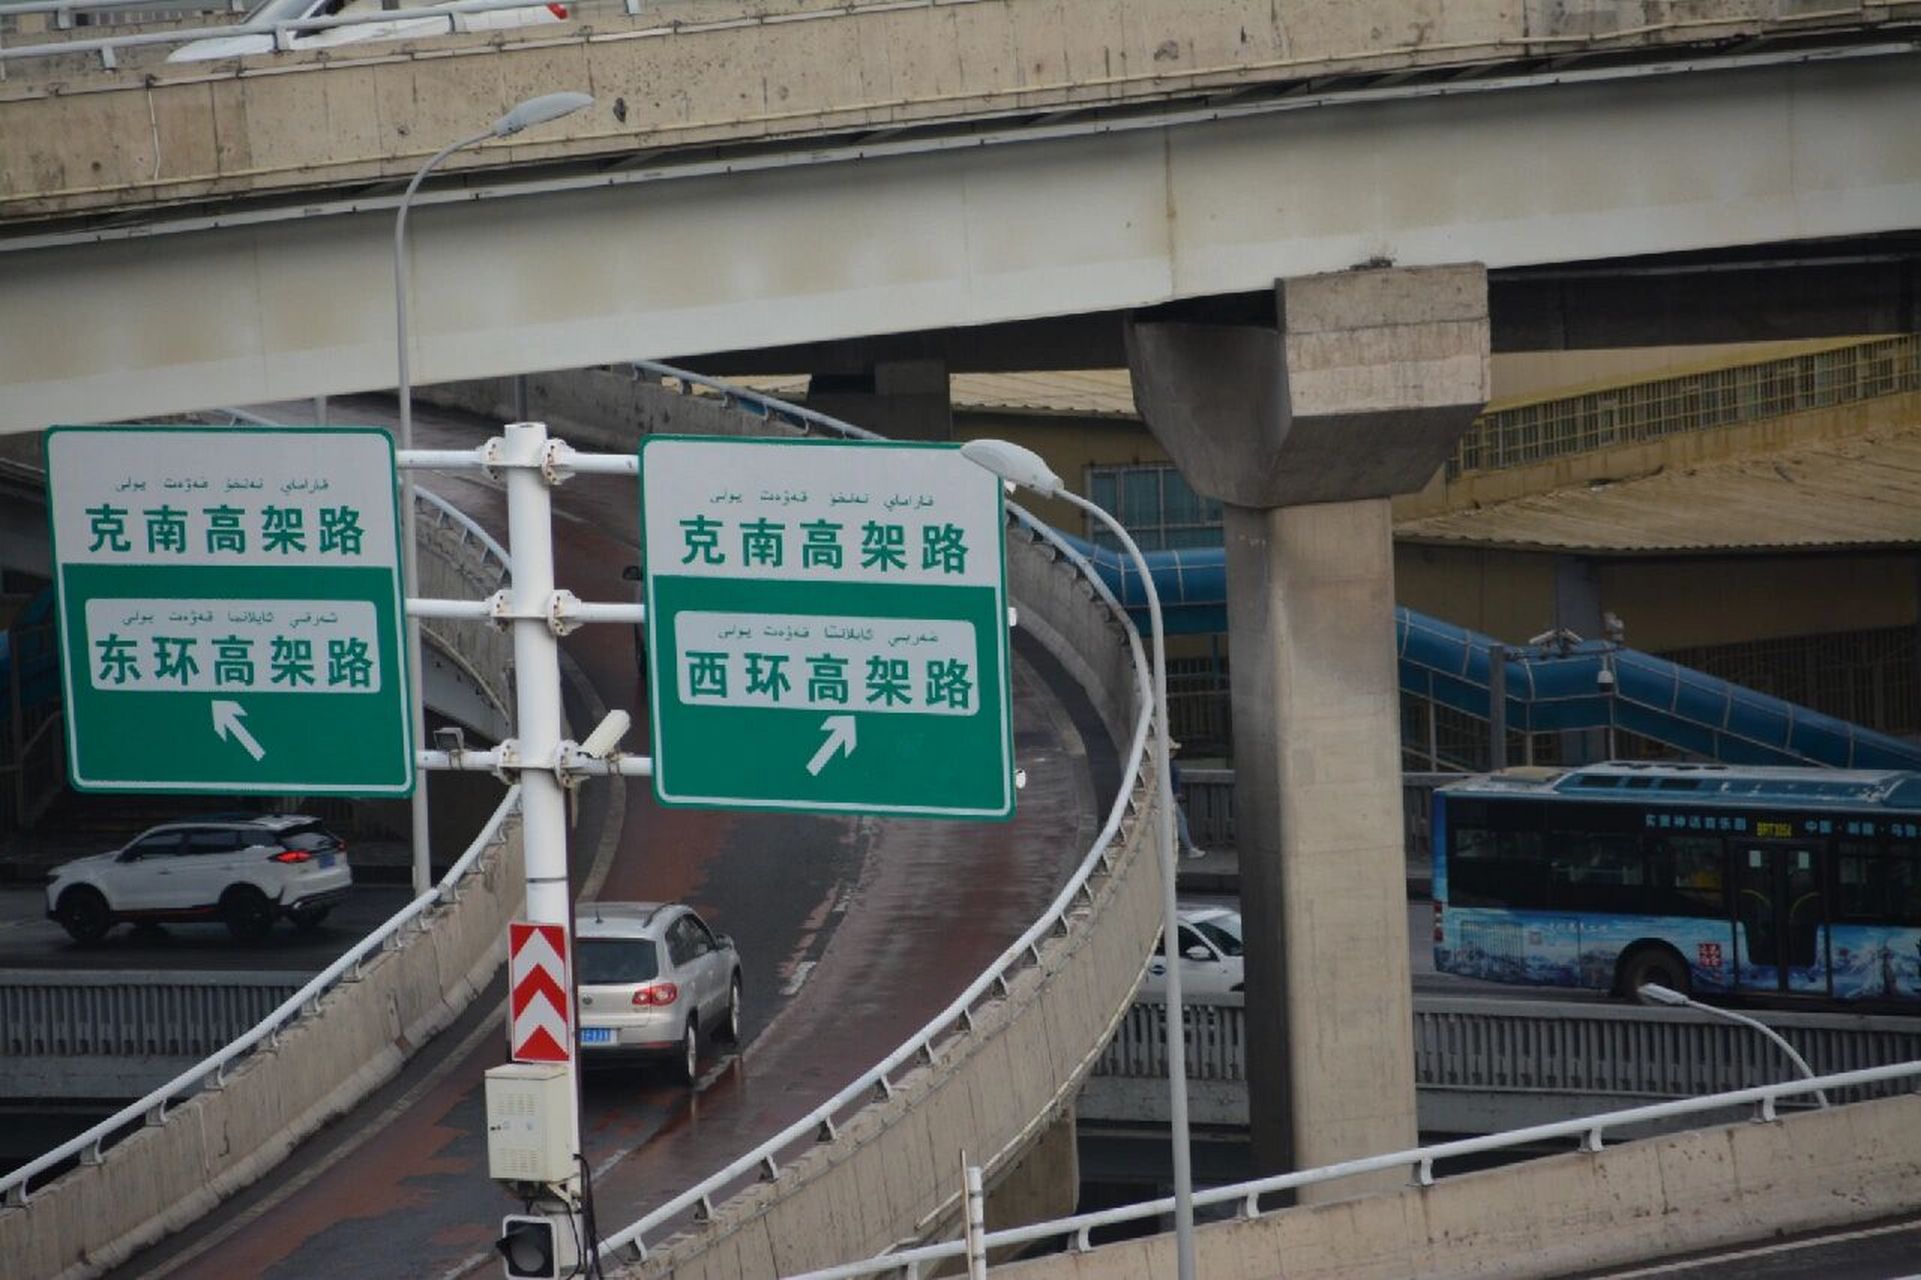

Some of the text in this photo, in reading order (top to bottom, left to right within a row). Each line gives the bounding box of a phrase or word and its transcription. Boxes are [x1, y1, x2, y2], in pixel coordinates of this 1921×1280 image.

[85, 503, 365, 556] 克南高架路
[679, 514, 969, 575] 克南高架路
[95, 633, 373, 688] 东环高架路
[685, 650, 973, 710] 西环高架路
